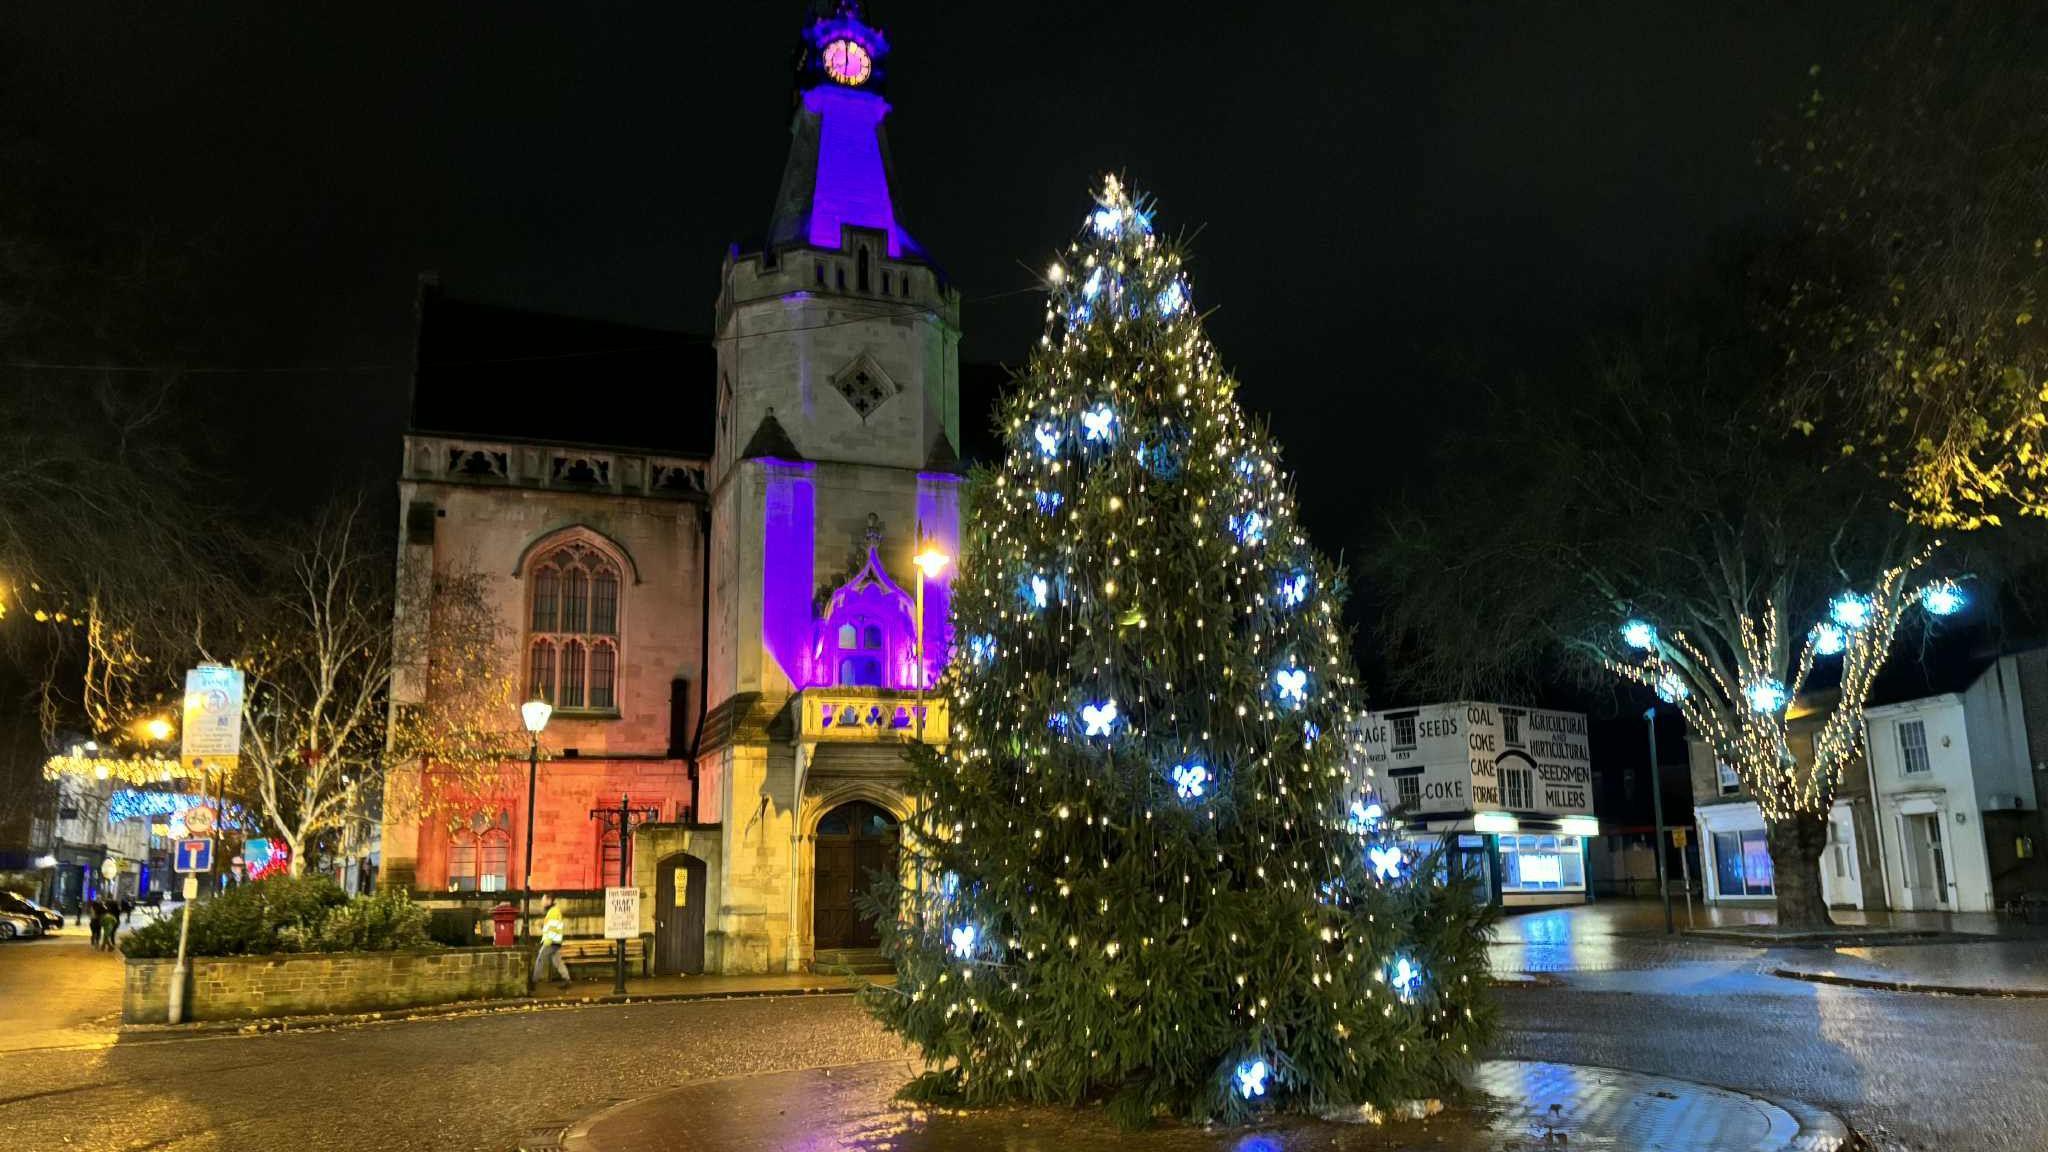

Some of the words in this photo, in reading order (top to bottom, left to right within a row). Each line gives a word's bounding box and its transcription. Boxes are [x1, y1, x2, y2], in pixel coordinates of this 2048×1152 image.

[1467, 707, 1494, 726] COAL
[1529, 712, 1587, 736] AGRICULTURAL
[1419, 718, 1458, 738] SEEDS
[1469, 734, 1496, 752] COKE
[1530, 740, 1590, 761] HORTICULTURAL
[1471, 760, 1496, 777] CAKE
[1538, 763, 1590, 783] SEEDSMEN
[1425, 781, 1463, 799] COKE
[1472, 785, 1499, 804] FORAGE
[1545, 790, 1586, 808] MILLERS
